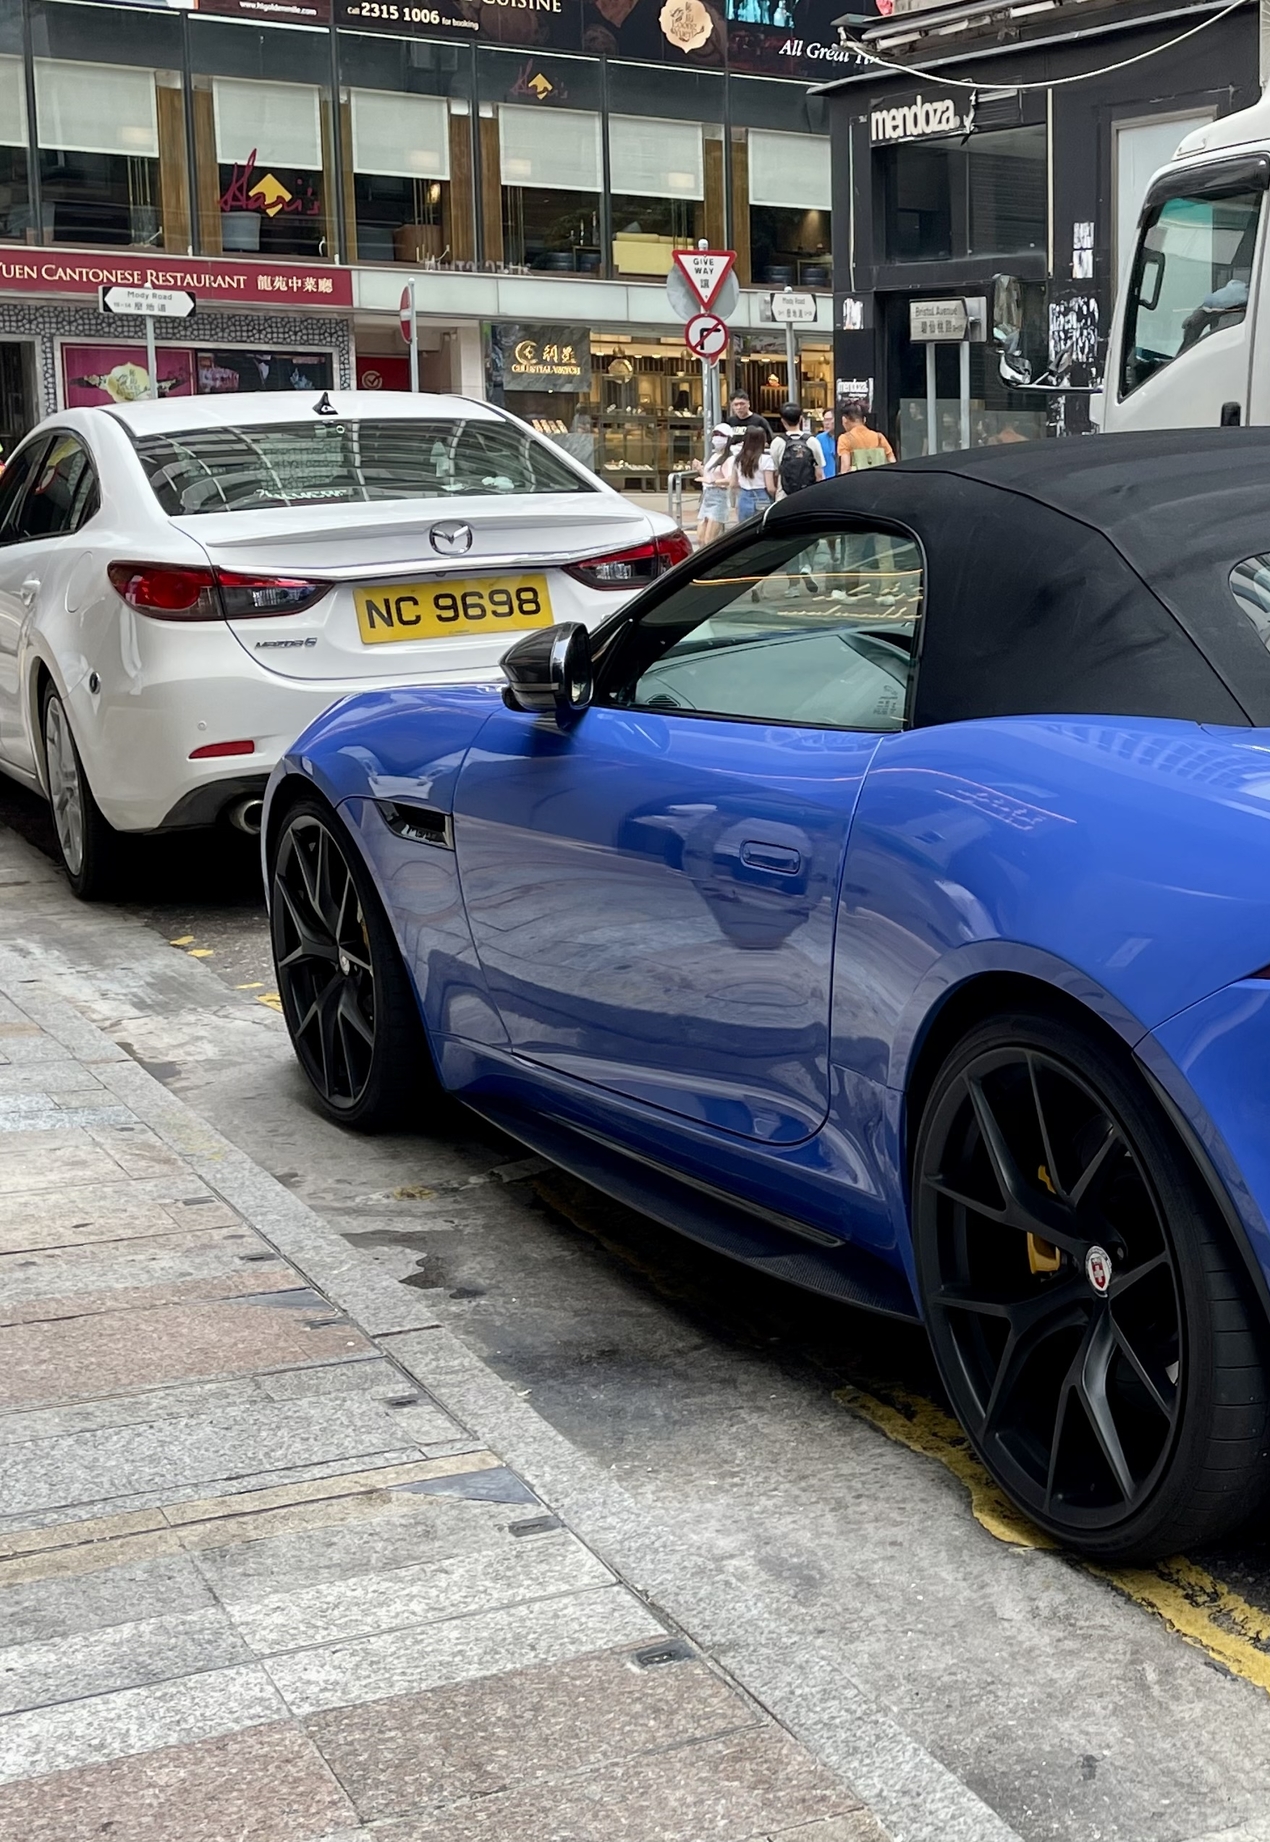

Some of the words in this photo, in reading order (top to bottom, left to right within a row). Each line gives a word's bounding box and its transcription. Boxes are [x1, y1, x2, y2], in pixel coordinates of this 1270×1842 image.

[361, 2, 399, 20] 2315
[403, 7, 440, 25] 1006
[442, 17, 451, 26] for
[452, 18, 480, 31] booking
[779, 39, 804, 57] All
[693, 257, 714, 266] GIVE
[41, 264, 142, 284] CANTONESE
[146, 269, 247, 289] RESTAURANT
[694, 267, 714, 275] WAY
[127, 291, 149, 300] Mody
[152, 292, 173, 301] Road
[915, 306, 935, 317] Bristol
[936, 305, 958, 316] Avenue
[365, 596, 421, 630] NC
[433, 586, 542, 623] 9698
